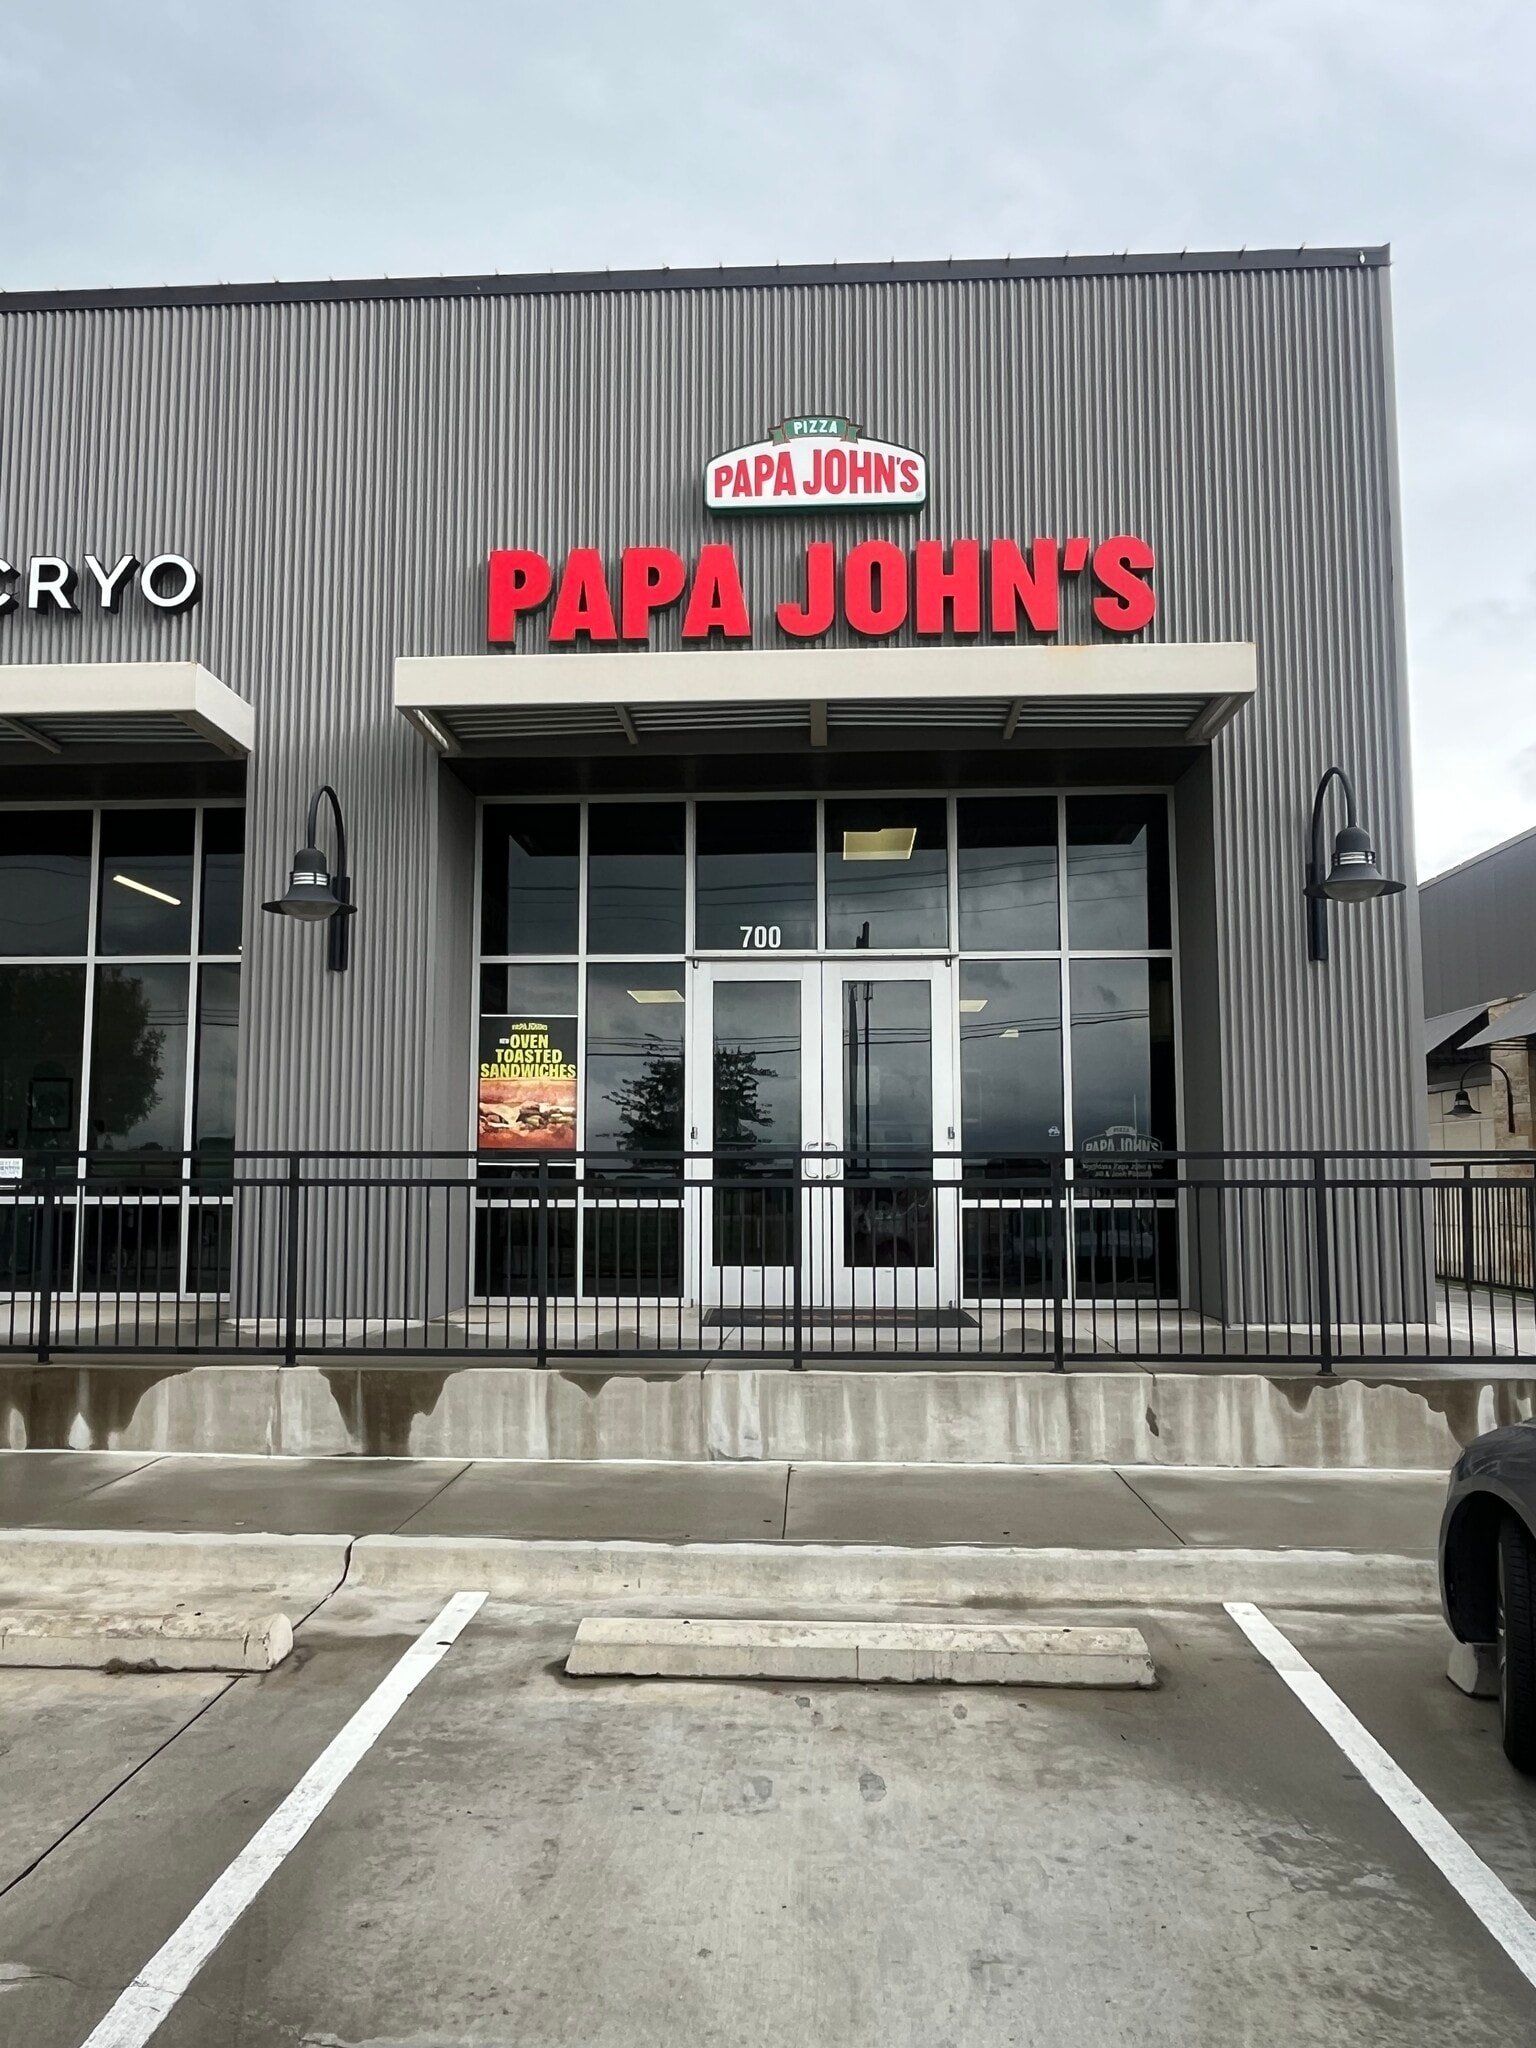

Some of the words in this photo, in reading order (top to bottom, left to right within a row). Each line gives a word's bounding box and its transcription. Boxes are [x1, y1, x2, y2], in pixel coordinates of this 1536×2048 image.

[793, 419, 838, 435] PIZZA
[714, 451, 797, 497] PAPA
[802, 449, 919, 495] JOHN'S
[0, 553, 197, 609] RYO
[487, 544, 751, 642] PAPA
[777, 536, 1156, 637] JOHN'S
[740, 925, 781, 948] 700
[510, 1034, 549, 1049] OVEN
[495, 1048, 563, 1063] TOASTED
[480, 1063, 577, 1078] SANDWICHES
